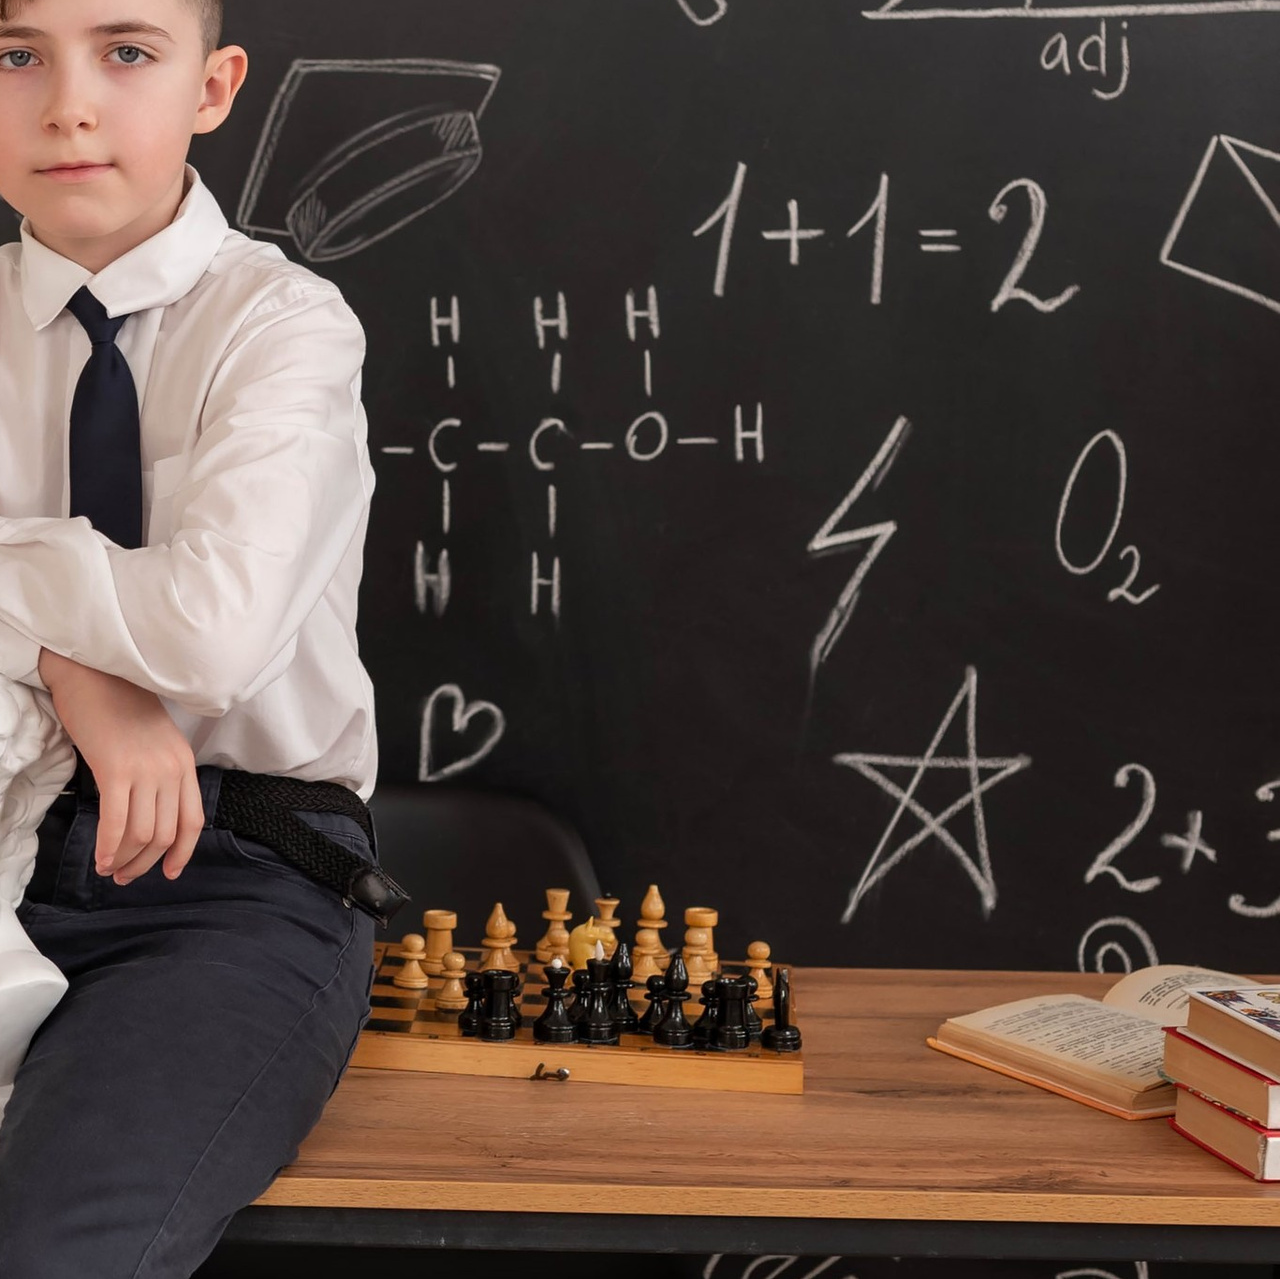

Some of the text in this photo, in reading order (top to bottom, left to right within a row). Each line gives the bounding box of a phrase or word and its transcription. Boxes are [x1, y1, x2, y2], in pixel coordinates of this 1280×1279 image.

[1041, 18, 1130, 100] adj
[431, 285, 660, 349] H H H
[415, 541, 561, 615] H H
